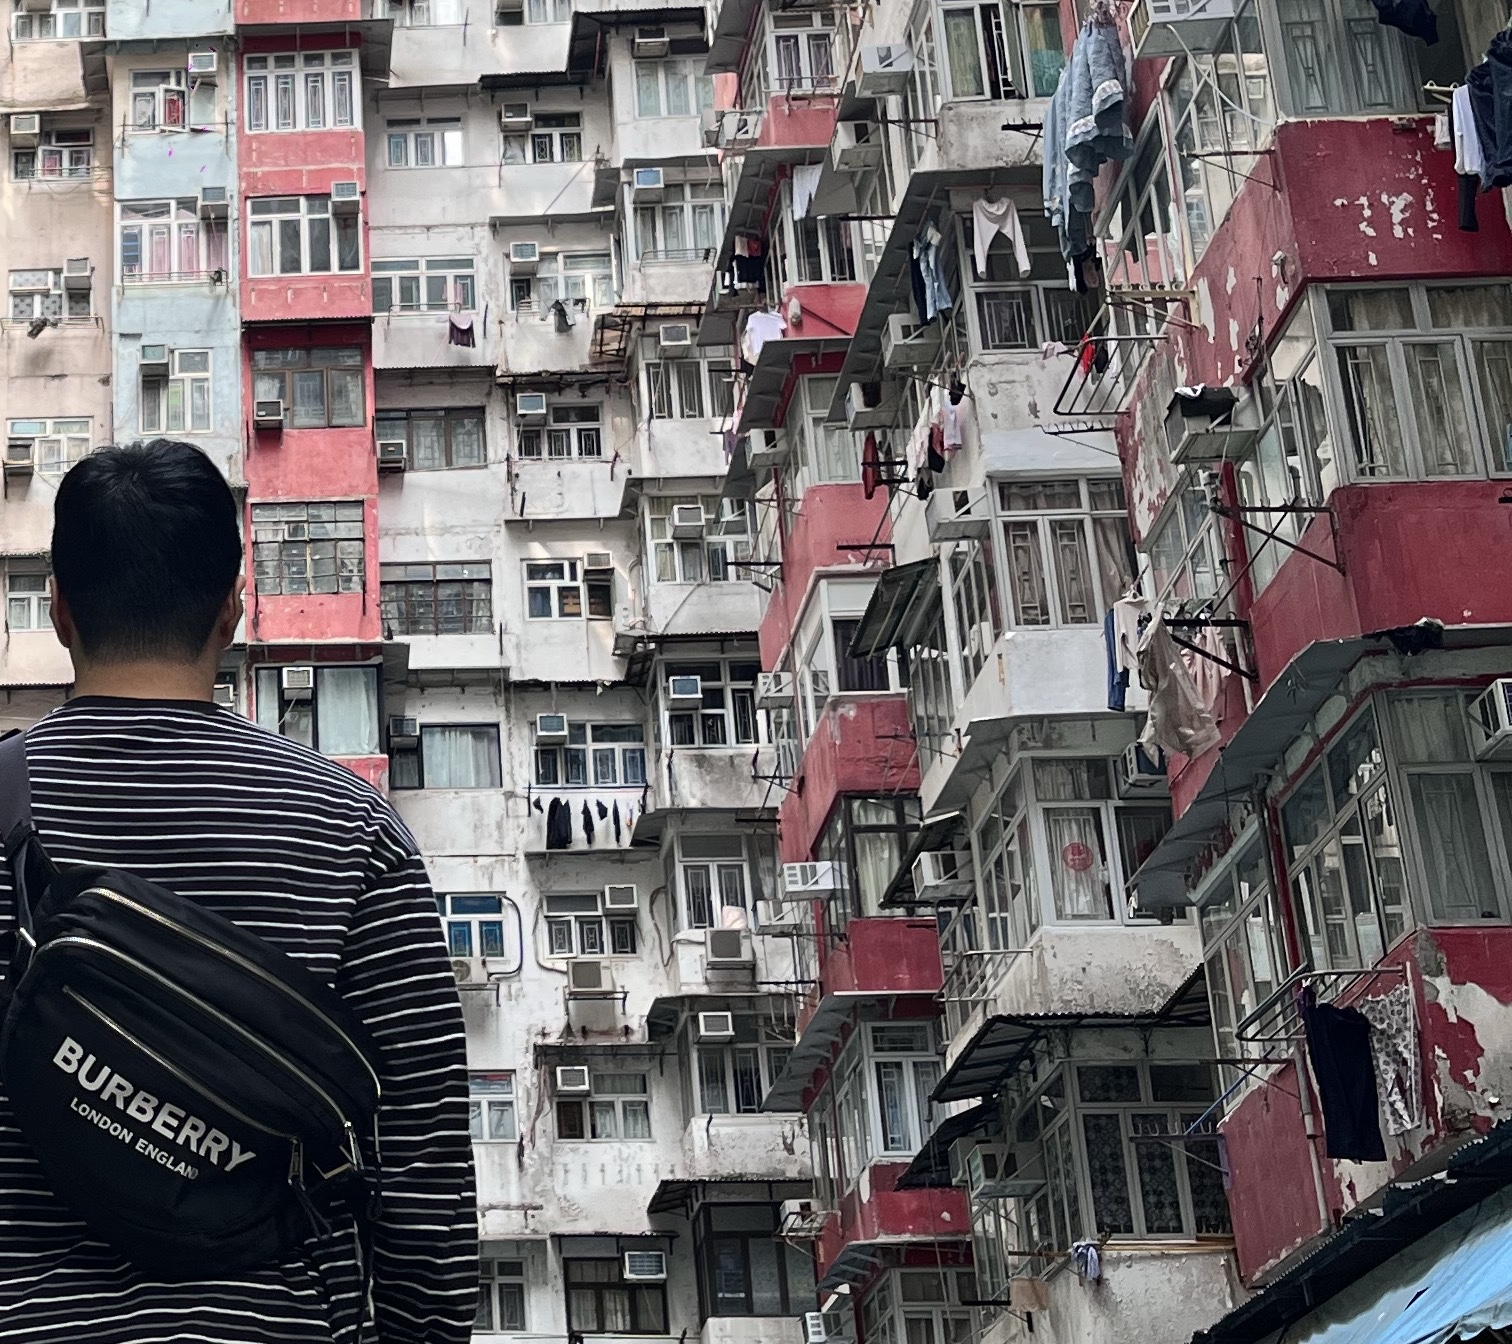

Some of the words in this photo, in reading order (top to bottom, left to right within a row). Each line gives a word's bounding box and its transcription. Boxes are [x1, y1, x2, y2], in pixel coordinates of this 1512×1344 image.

[53, 1036, 256, 1172] BURBERRY
[70, 1097, 133, 1143] LONDON
[135, 1138, 199, 1180] ENGLAND
